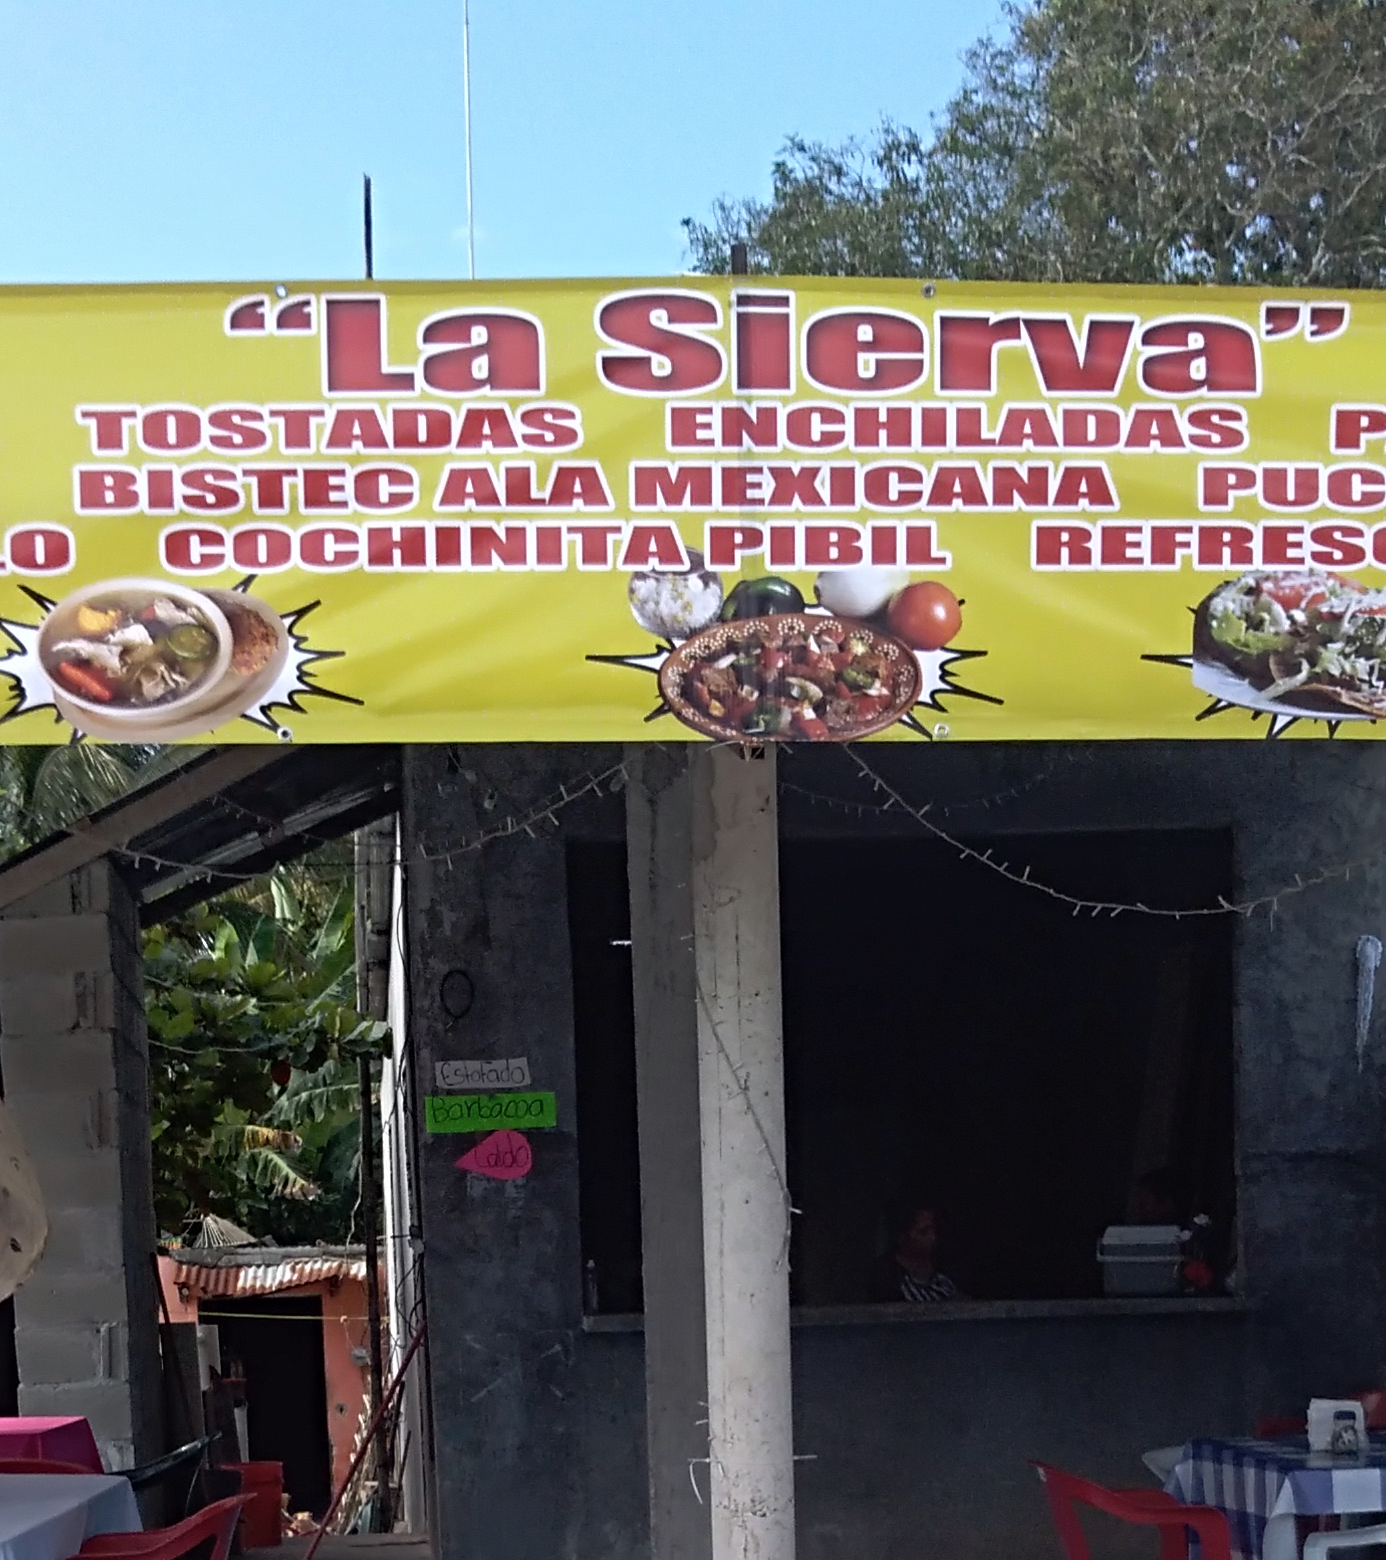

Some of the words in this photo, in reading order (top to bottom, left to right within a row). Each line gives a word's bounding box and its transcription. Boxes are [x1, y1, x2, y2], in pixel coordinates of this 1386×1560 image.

[77, 403, 582, 454] TOSTADAS
[666, 402, 1248, 452] ENCHILADAS
[75, 463, 418, 514] BISTEC
[436, 462, 612, 511] ALA
[630, 461, 1118, 511] MEXICANA
[160, 521, 688, 573] COCHINITA
[704, 521, 951, 570] PIBIL
[432, 1097, 545, 1123] Barbacoa
